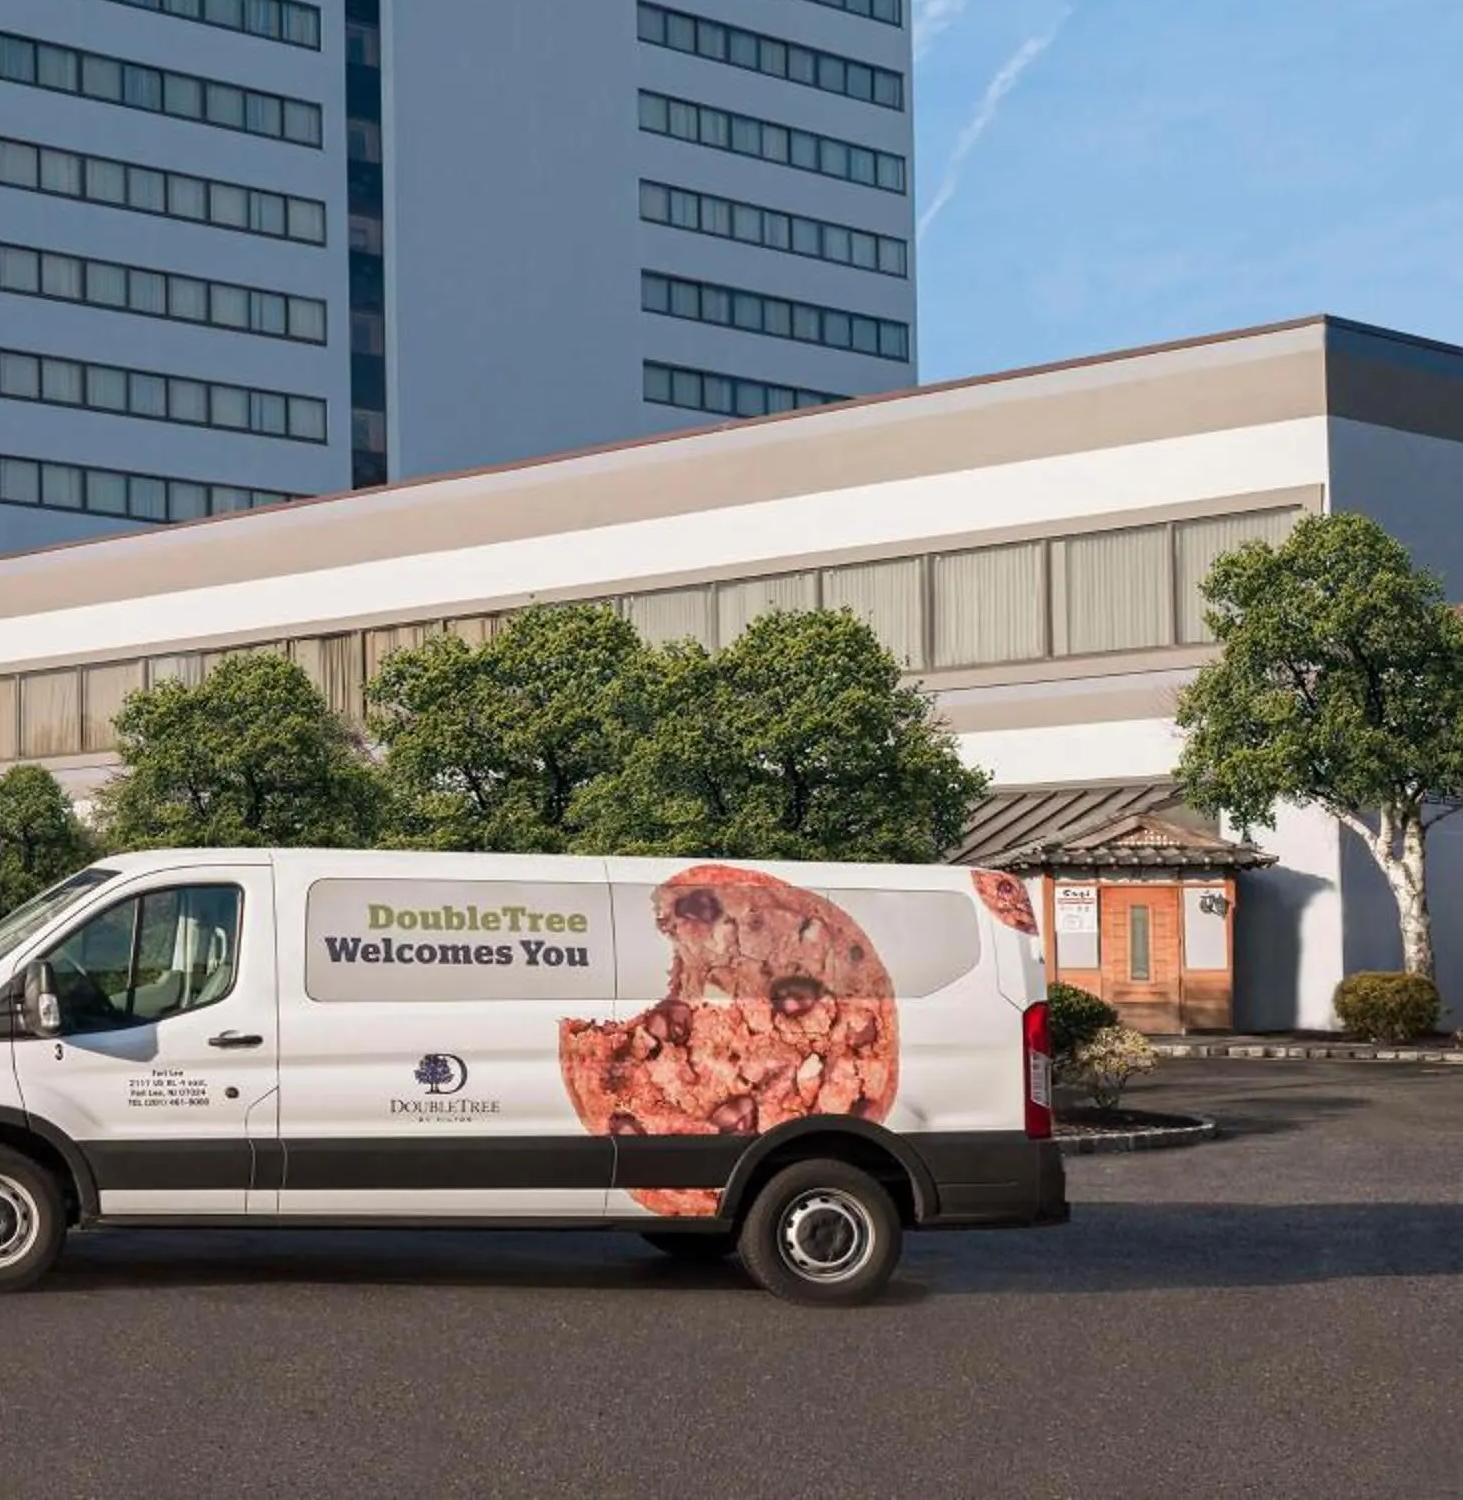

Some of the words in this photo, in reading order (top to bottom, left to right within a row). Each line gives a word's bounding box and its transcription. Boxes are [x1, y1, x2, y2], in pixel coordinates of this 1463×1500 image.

[367, 904, 588, 933] DoubleTree
[325, 936, 514, 966] Welcomes
[520, 939, 590, 967] You
[54, 1043, 64, 1061] 3
[390, 1099, 501, 1113] DOUBLETREE
